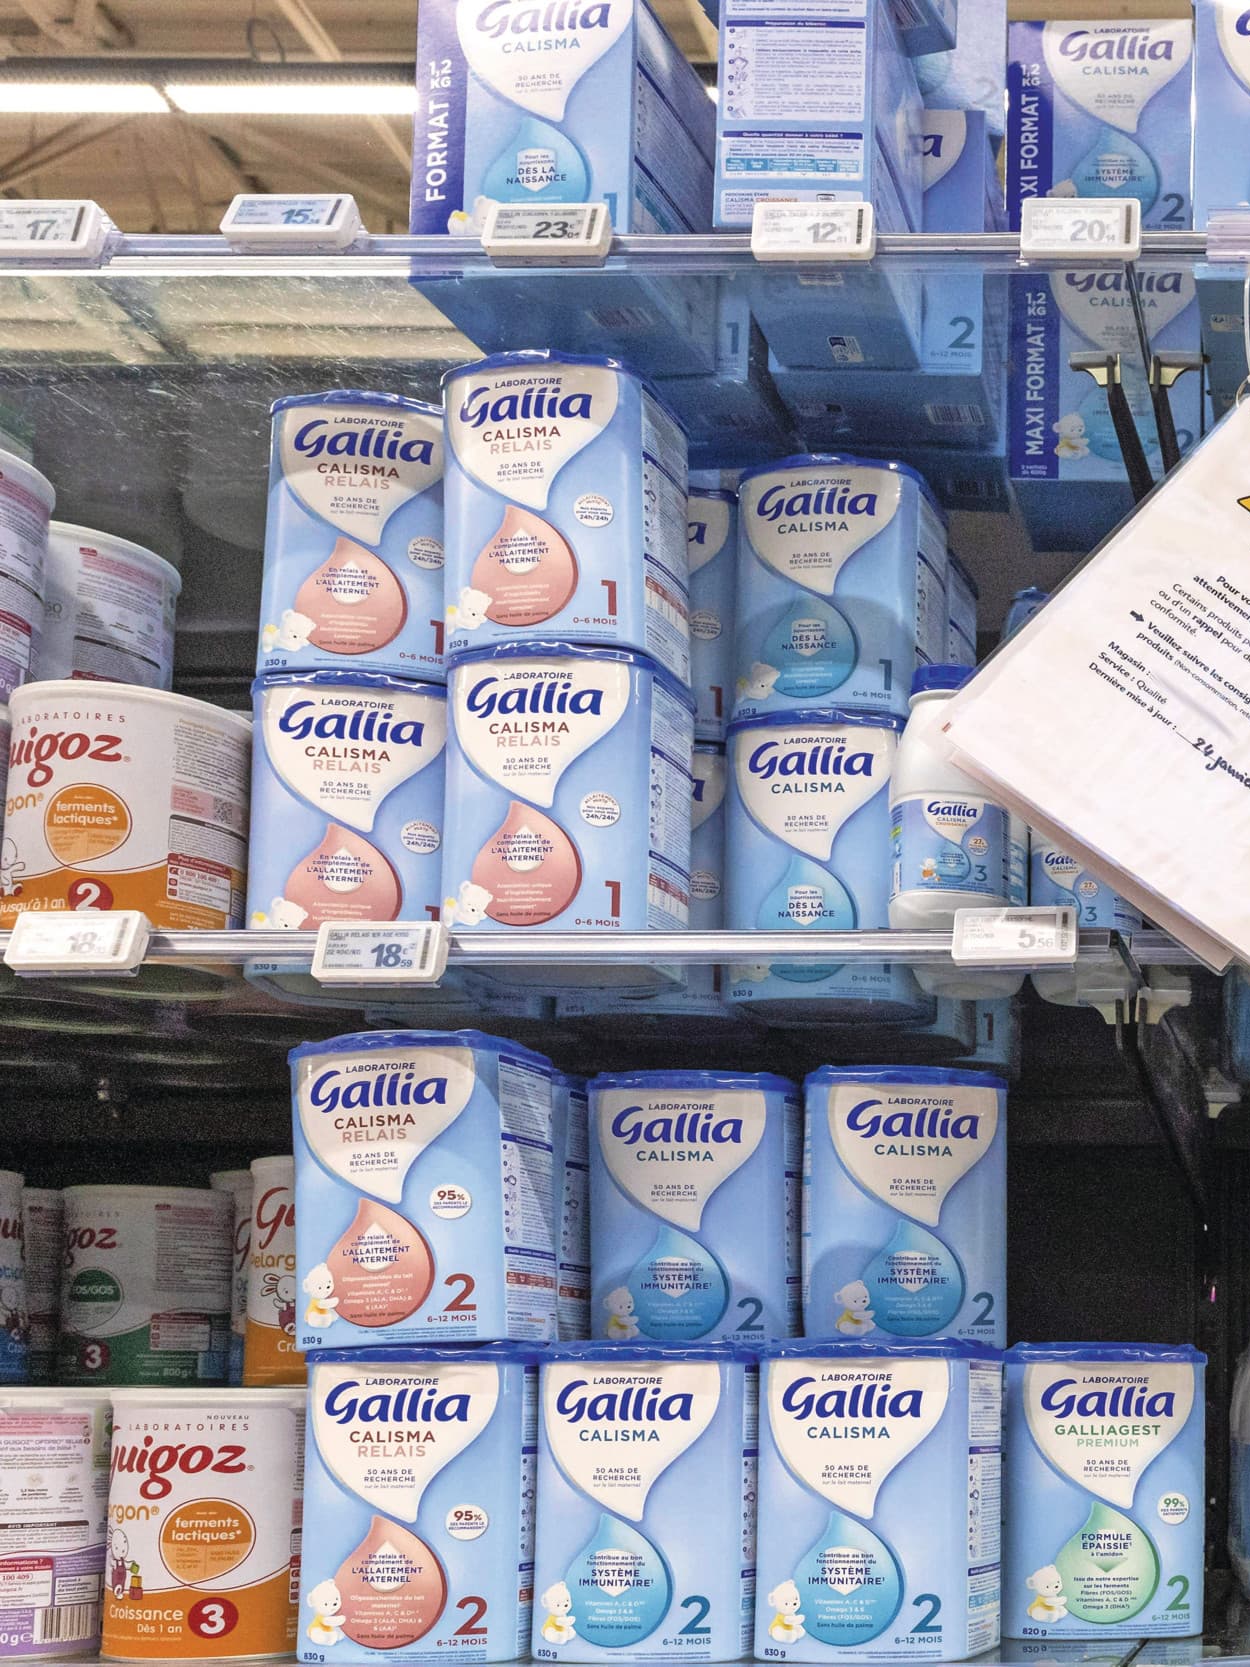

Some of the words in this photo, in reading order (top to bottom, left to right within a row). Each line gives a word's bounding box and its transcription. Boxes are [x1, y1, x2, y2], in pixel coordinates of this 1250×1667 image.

[1059, 30, 1174, 62] Gallia
[1082, 65, 1149, 76] CALISMA
[425, 100, 450, 202] FORMAT
[532, 221, 568, 239] 23
[1026, 322, 1045, 402] FORMAT
[494, 378, 562, 388] LABORATOIRE
[459, 387, 592, 428] Gallia
[483, 426, 561, 442] CALISMA
[1026, 406, 1045, 455] MAXI
[294, 419, 434, 465] Gallia
[490, 439, 552, 454] RELAIS
[317, 463, 399, 479] CALISMA
[325, 476, 390, 489] RELAIS
[489, 547, 549, 558] L'ALLAITEMENT
[499, 556, 541, 564] MATERNEL
[1215, 575, 1241, 596] Pour
[1149, 599, 1198, 637] conformité.
[1172, 583, 1209, 613] Certains
[1206, 610, 1243, 640] produits
[1158, 590, 1172, 601] ou
[1170, 599, 1192, 617] d'un
[1191, 614, 1224, 640] rappel
[1219, 637, 1243, 654] pour
[1135, 631, 1174, 661] produits
[1147, 620, 1183, 652] Veuillez
[1178, 649, 1210, 673] suivre
[1209, 668, 1224, 683] les
[1107, 640, 1146, 673] Magasin
[1097, 651, 1131, 678] Service
[1135, 679, 1168, 705] Qualité
[466, 676, 603, 719] Gallia
[1088, 661, 1126, 693] Dernière
[1125, 690, 1147, 708] mise
[1146, 704, 1154, 714] à
[1151, 709, 1173, 726] jour
[278, 700, 424, 747] Gallia
[489, 721, 570, 735] CALISMA
[496, 733, 560, 748] RELAIS
[1190, 737, 1214, 759] 24
[305, 746, 390, 761] CALISMA
[748, 741, 874, 780] Gallia
[313, 760, 381, 774] RELAIS
[771, 782, 845, 794] CALISMA
[55, 802, 116, 815] ferments
[927, 800, 977, 820] Gallia
[1018, 930, 1034, 949] 5
[1037, 938, 1053, 948] 56
[370, 944, 400, 968] 18
[400, 959, 412, 968] 59
[346, 1062, 416, 1074] LABORATOIRE
[311, 1070, 448, 1113] Gallia
[334, 1113, 416, 1129] CALISMA
[847, 1100, 980, 1140] Gallia
[342, 1128, 407, 1143] RELAIS
[874, 1144, 952, 1157] CALISMA
[437, 1190, 465, 1201] 95%
[324, 1380, 471, 1424] Gallia
[556, 1380, 693, 1424] Gallia
[782, 1377, 923, 1420] Gallia
[1041, 1377, 1175, 1419] Gallia
[129, 1423, 249, 1431] LABORATOIRES
[579, 1429, 660, 1441] CALISMA
[807, 1426, 890, 1439] CALISMA
[1055, 1425, 1161, 1436] GALLIAGEST
[349, 1431, 435, 1443] CALISMA
[1077, 1438, 1139, 1448] PREMIUM
[358, 1444, 426, 1458] RELAIS
[175, 1517, 240, 1528] ferments
[110, 1607, 183, 1621] Croissance
[200, 1604, 225, 1634] 3
